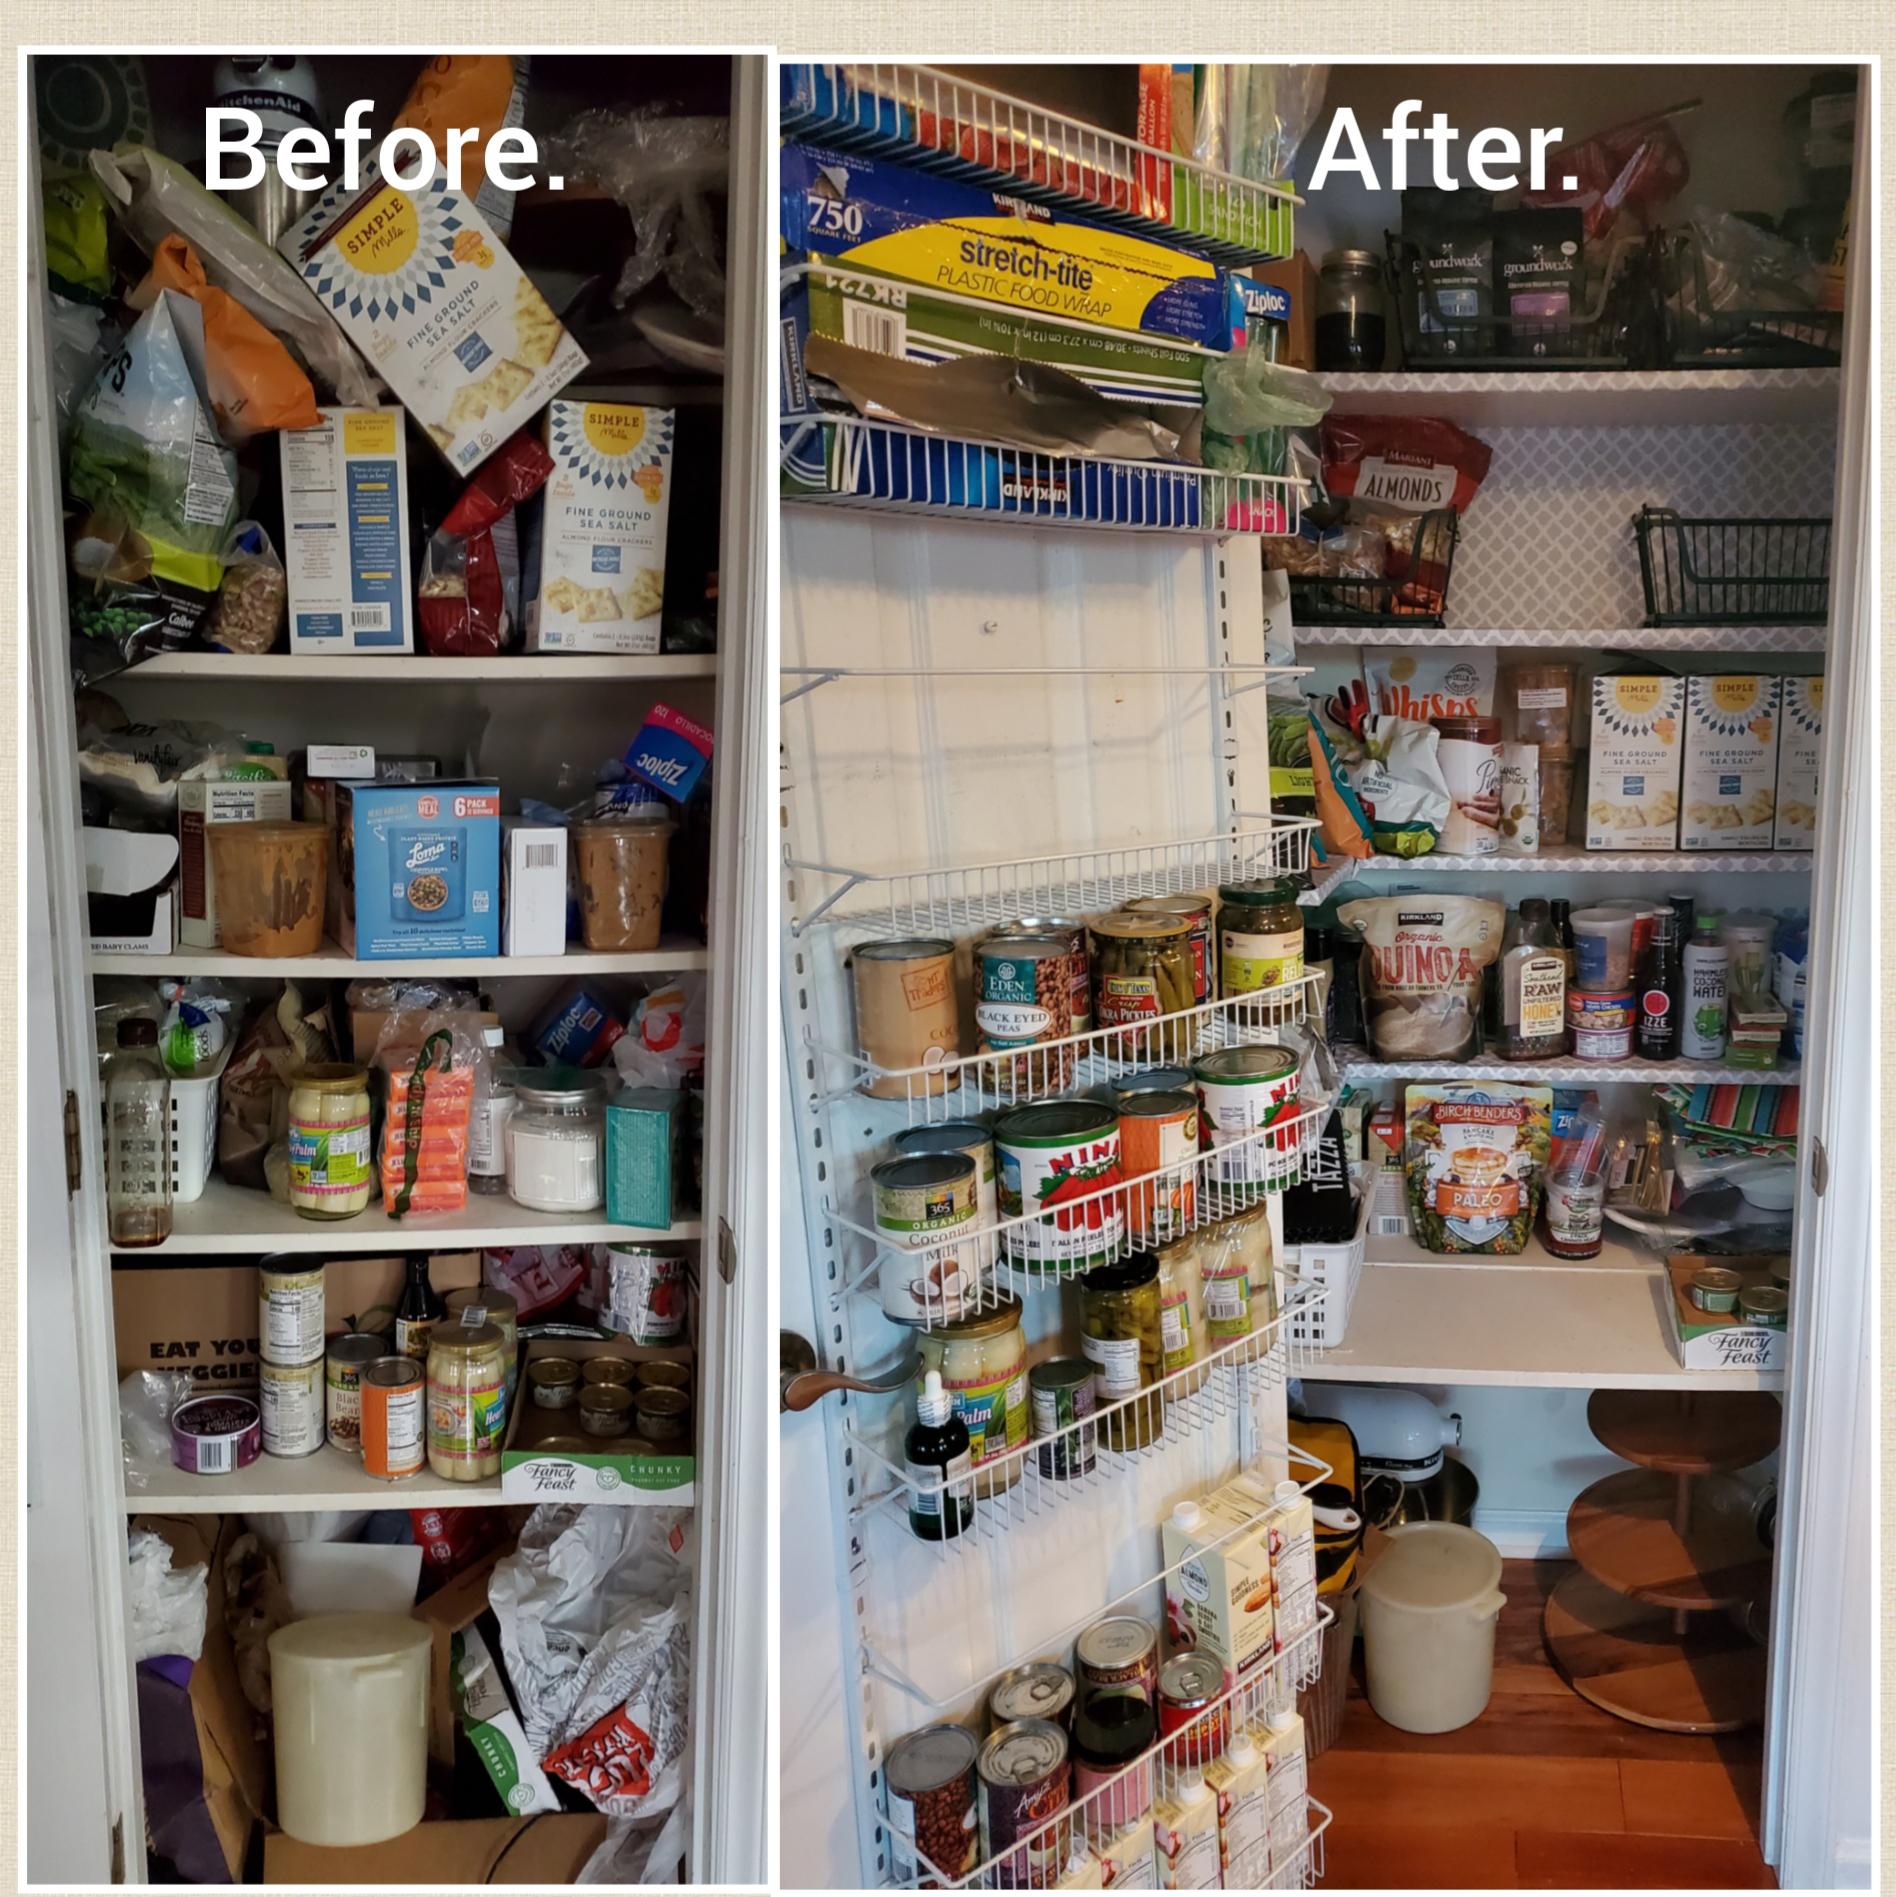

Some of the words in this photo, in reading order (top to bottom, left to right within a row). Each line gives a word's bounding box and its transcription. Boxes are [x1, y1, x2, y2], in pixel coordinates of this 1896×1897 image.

[1137, 82, 1149, 144] TORAGE
[807, 196, 864, 236] 750
[346, 197, 405, 255] SIMPLE
[807, 225, 840, 240] SQUARE
[842, 232, 862, 244] FEET
[959, 238, 1093, 293] stretch-tite
[1412, 253, 1484, 273] gundwork
[1503, 255, 1574, 277] groundwork
[936, 265, 1009, 297] PLASTIC
[1009, 283, 1059, 309] FOOD
[1063, 296, 1112, 317] WRAP
[1245, 289, 1286, 315] Ziploc
[406, 322, 433, 349] FINE
[434, 280, 480, 324] GROUND
[426, 325, 449, 347] SEA
[449, 298, 477, 326] SALT
[1089, 338, 1104, 349] cm
[1174, 350, 1191, 363] 500
[786, 326, 804, 405] KIRKLAND
[588, 412, 640, 428] SIMPLE
[1363, 474, 1444, 503] ALMONDS
[565, 506, 594, 517] FINE
[599, 508, 652, 521] GROUND
[579, 519, 603, 529] SEA
[608, 521, 638, 532] SALT
[1619, 684, 1658, 694] SIMPLE
[1715, 683, 1754, 693] SIMPLE
[674, 716, 715, 744] OCADILLO
[1627, 750, 1668, 758] GROUND
[1710, 757, 1729, 765] SEA
[1731, 757, 1754, 765] SALT
[1724, 749, 1764, 757] GROUND
[636, 752, 689, 787] Ziploc
[1613, 758, 1632, 766] SEA
[1635, 758, 1657, 766] SALT
[454, 797, 466, 817] 6
[467, 799, 487, 808] PACK
[1399, 913, 1443, 922] KIRKLAND
[1395, 931, 1445, 944] Organic
[989, 975, 1025, 992] EDEN
[1523, 981, 1562, 997] RAW
[1692, 985, 1726, 999] WATE
[985, 991, 1032, 1003] ORGANIC
[977, 1009, 1010, 1024] BLACK
[1014, 1011, 1047, 1024] EYED
[1522, 1002, 1562, 1020] HONEY
[546, 1006, 582, 1052] Ziploc
[996, 1023, 1021, 1033] PEAS
[1643, 1015, 1668, 1028] IZZE
[1435, 1105, 1472, 1120] BIRCH
[1474, 1106, 1522, 1121] BENDERS
[1311, 1136, 1344, 1192] TAZZA
[1453, 1192, 1502, 1208] PALEO
[929, 1202, 951, 1216] 365
[912, 1212, 968, 1231] ORGANIC
[908, 1224, 969, 1248] Coconut
[150, 1341, 200, 1359] EAT
[209, 1338, 261, 1356] YOU
[1708, 1331, 1775, 1351] Fancy
[1720, 1347, 1771, 1366] Feast
[335, 1392, 360, 1405] Blac
[335, 1402, 360, 1414] Bean
[956, 1406, 993, 1426] Palm
[524, 1462, 577, 1482] Fancy
[630, 1464, 681, 1475] CHUNKY
[534, 1478, 577, 1492] Feast
[480, 1736, 507, 1779] CHUNKY
